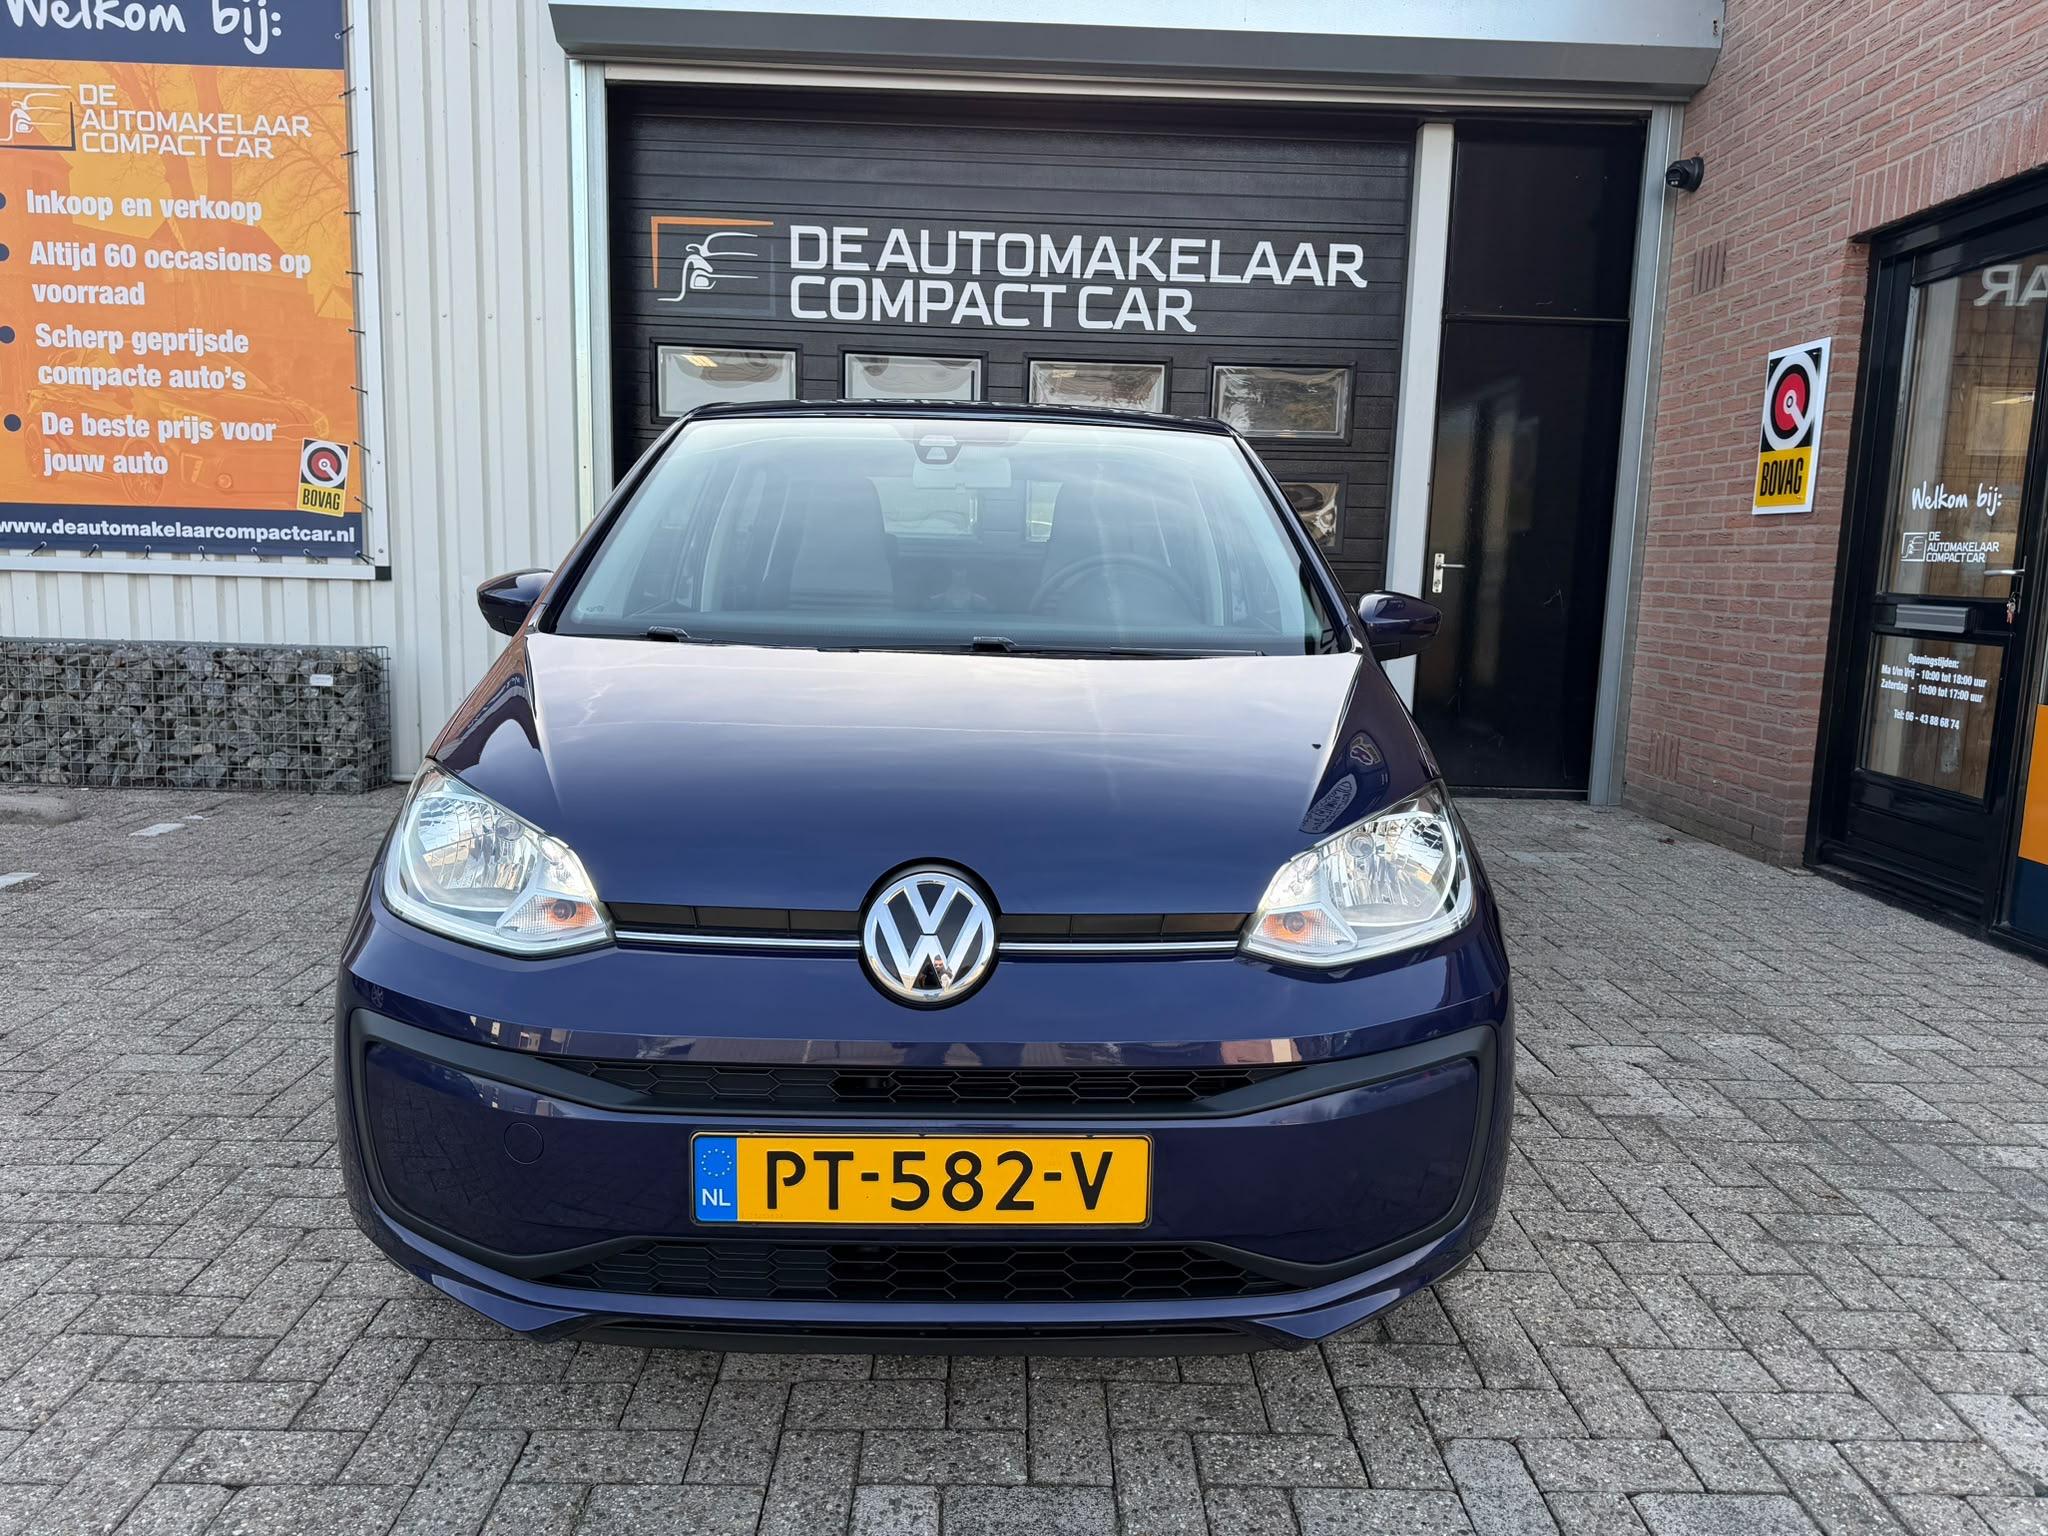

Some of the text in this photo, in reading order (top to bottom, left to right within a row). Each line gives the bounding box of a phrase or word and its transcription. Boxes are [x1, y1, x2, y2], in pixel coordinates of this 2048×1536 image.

[212, 0, 282, 54] bij:
[79, 83, 118, 106] DE
[81, 110, 312, 138] AUTOMAKELAAR
[82, 132, 275, 160] COMPACT CAR
[27, 189, 262, 225] Inkoop en verkoop
[30, 241, 312, 278] Altijd 60 occasions op
[789, 225, 1369, 288] DE AUTOMAKELAAR
[32, 282, 146, 305] voorraad
[790, 276, 1197, 332] COMPACT CAR
[35, 323, 249, 357] Scherp geprijsde
[38, 364, 162, 390] compacte
[42, 412, 277, 444] De beste prijs voor
[43, 448, 169, 477] jouw auto
[1760, 457, 1804, 497] BOVAG
[302, 488, 341, 511] BOVAG
[1911, 480, 2003, 516] Welkom bij:
[0, 518, 355, 542] www.deautomakelaarcompactcar.nl
[1928, 531, 1941, 541] DE
[1926, 552, 1986, 563] COMPACT CAR
[1927, 541, 1999, 552] AUTOMAKELAAR
[1908, 653, 1960, 669] Openingstijden:
[1881, 664, 1891, 675] Ma
[1892, 664, 1903, 676] t/m
[1904, 666, 1916, 679] Vrij
[1921, 669, 1940, 681] 10:00
[1941, 672, 1951, 683] tot
[1953, 673, 1972, 686] 18:00
[1973, 678, 1987, 688] uur
[1881, 678, 1908, 693] Zaterdag
[1918, 684, 1937, 696] 10:00
[1937, 687, 1948, 698] tot
[1949, 688, 1969, 701] 17:00
[1970, 693, 1984, 703] uur
[1893, 708, 1905, 720] Tel:
[1905, 711, 1914, 721] 06
[1919, 714, 1928, 724] 43
[1950, 719, 1960, 730] 74
[766, 1150, 1113, 1212] PT-582-V
[701, 1188, 731, 1208] NL
